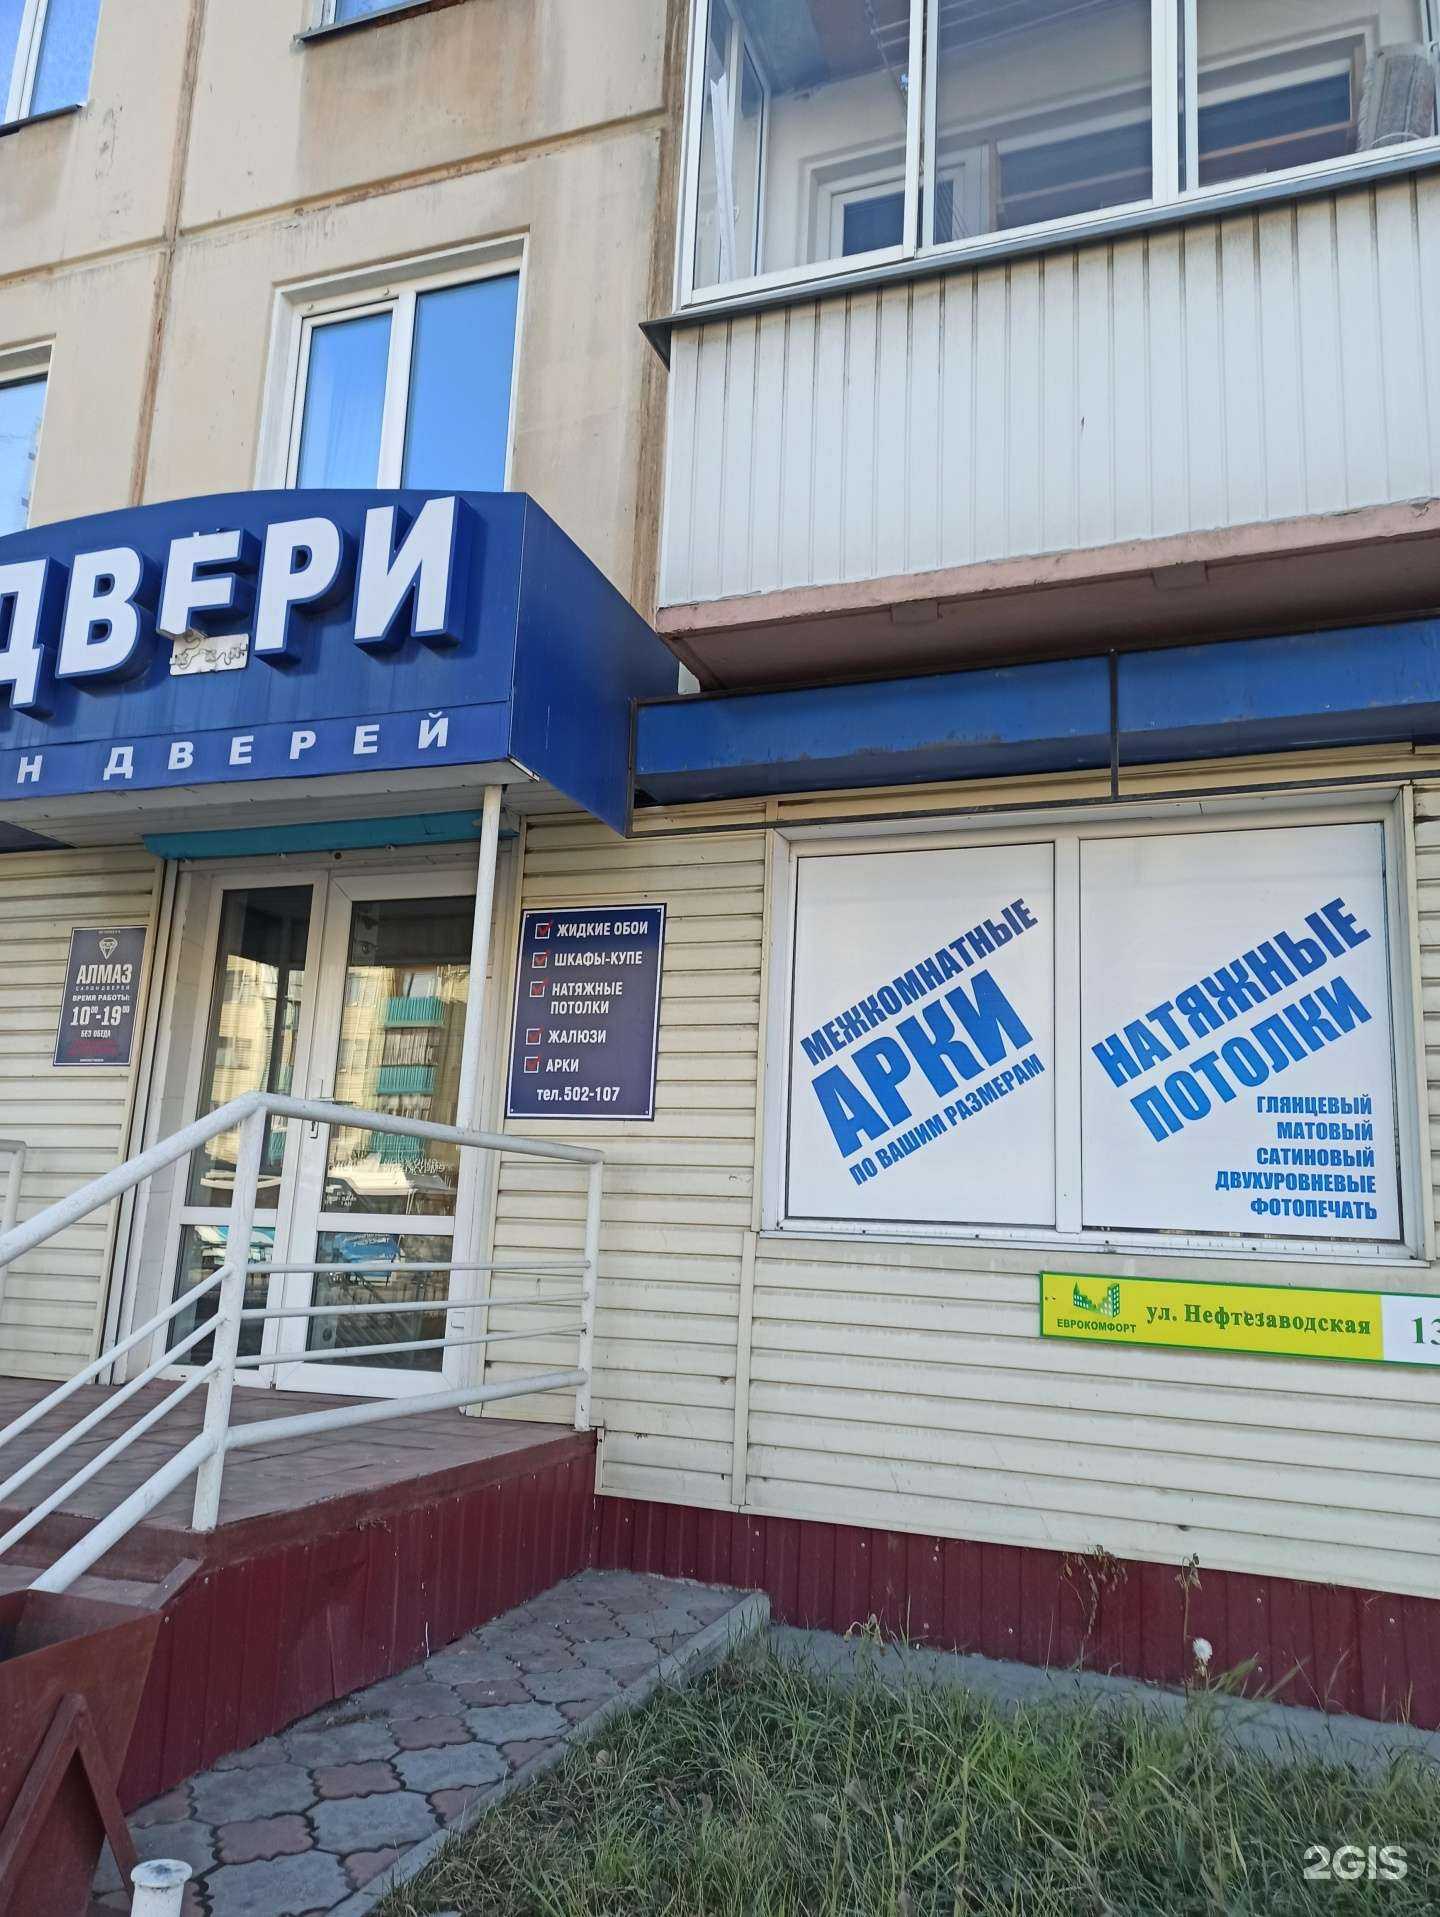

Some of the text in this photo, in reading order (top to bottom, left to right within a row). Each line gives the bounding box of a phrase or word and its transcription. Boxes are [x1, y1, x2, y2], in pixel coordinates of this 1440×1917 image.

[0, 496, 456, 706] ДВЕРИ
[103, 711, 449, 781] ДВЕРЕЙ
[557, 921, 649, 938] ЖИДКИЕ ОБОИ
[554, 951, 643, 967] ШКАФЫ-КУПЕ
[76, 963, 133, 985] АЛМАЗ
[801, 898, 1038, 1066] МЕЖКОМНАТНЫЕ
[72, 994, 97, 1002] ВРЕМЯ
[552, 981, 623, 996] НАТЯЖНЫЕ
[1091, 897, 1372, 1088] НАТЯЖНЫЕ
[550, 1000, 610, 1015] ПОТОЛКИ
[80, 1029, 92, 1038] БЕЗ
[548, 1029, 607, 1044] ЖАЛЮЗИ
[546, 1058, 579, 1073] АРКИ
[811, 968, 1033, 1159] АРКИ
[1130, 975, 1373, 1143] ПОТОЛКИ
[1256, 1093, 1374, 1116] ГЛЯНЦЕВЫЙ
[849, 1053, 1046, 1185] ПО ВАШИМ РАЗМЕРАМ
[1276, 1120, 1375, 1141] МАТОВЫЙ
[1256, 1146, 1376, 1168] САТИНОВЫЙ
[1215, 1170, 1377, 1194] ДВУХУРОВНЕВЫЕ
[1250, 1197, 1378, 1220] ФОТОПЕЧАТЬ
[1056, 1318, 1137, 1334] ЕВРОКОМФОРТ
[1145, 1303, 1372, 1336] ул. Нефтезаводская
